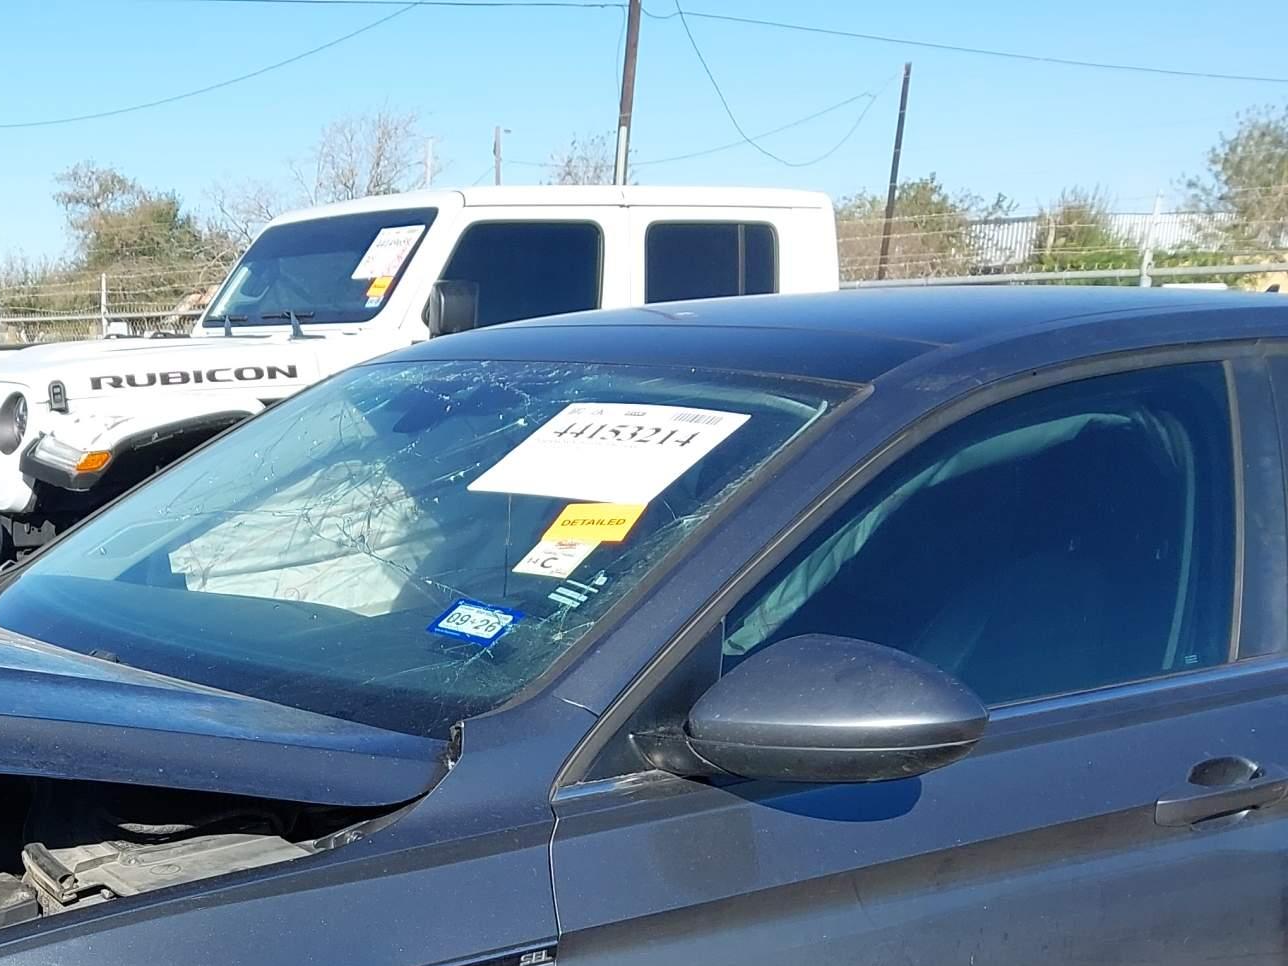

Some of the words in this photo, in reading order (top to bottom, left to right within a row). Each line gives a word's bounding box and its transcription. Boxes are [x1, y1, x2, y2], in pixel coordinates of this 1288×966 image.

[89, 365, 299, 391] RUBICON
[552, 422, 701, 448] 44153214
[560, 518, 627, 527] DETAILED
